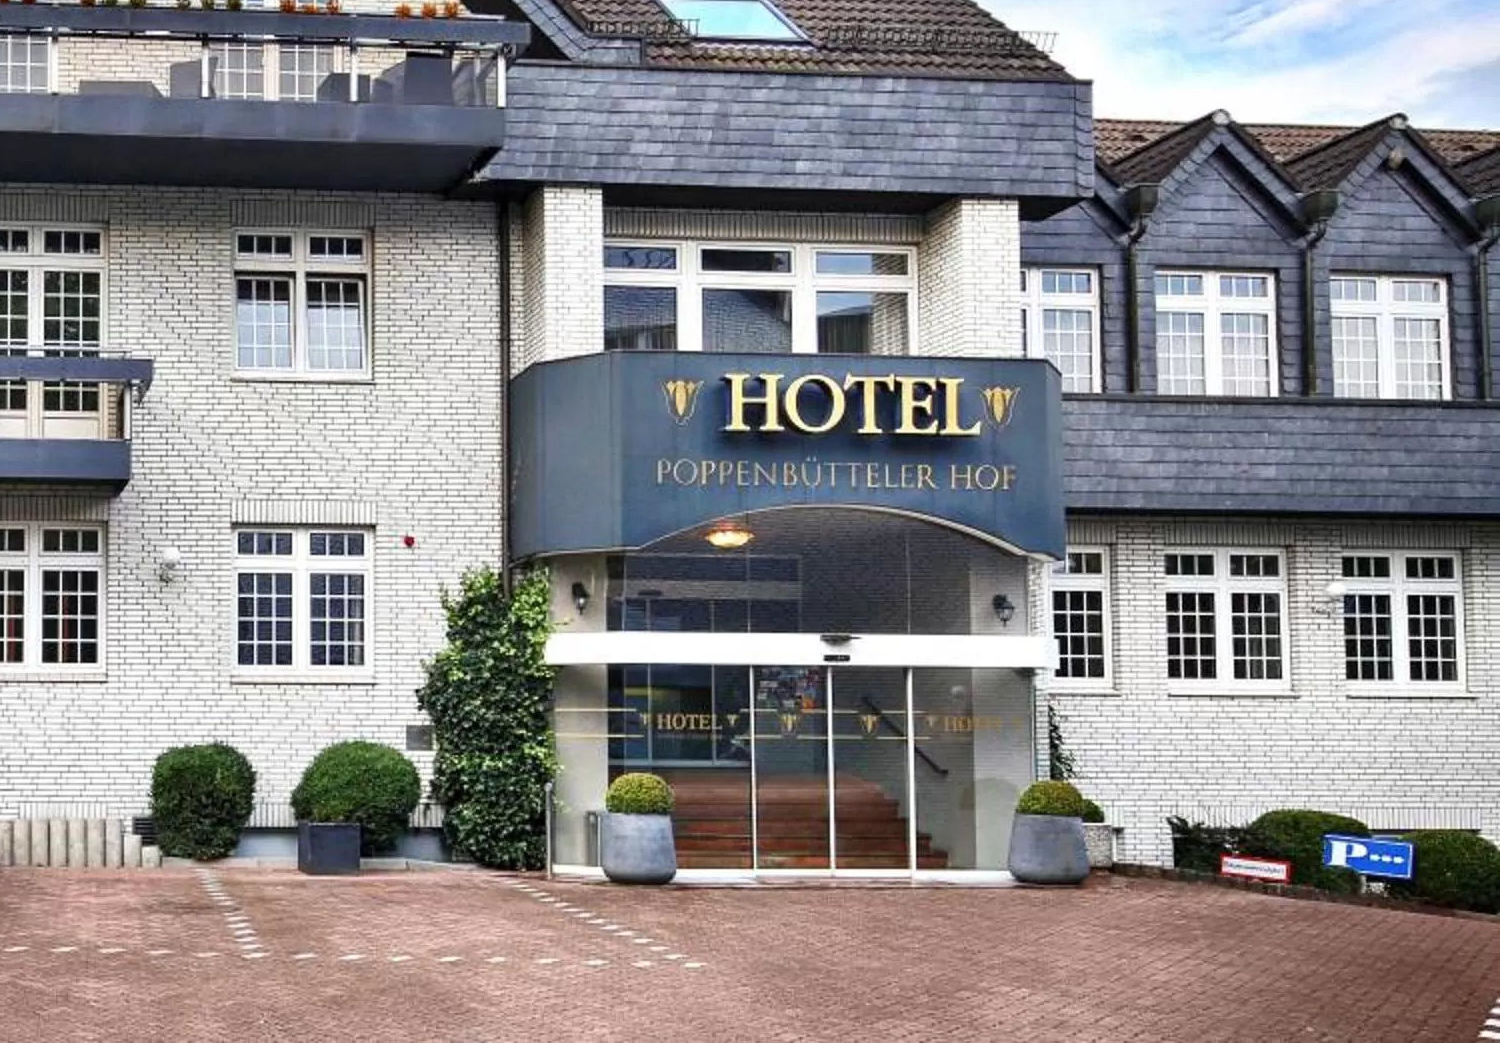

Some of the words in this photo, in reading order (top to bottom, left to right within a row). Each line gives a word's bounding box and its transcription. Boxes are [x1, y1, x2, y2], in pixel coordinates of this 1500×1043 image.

[723, 373, 982, 436] HOTEL
[656, 457, 940, 490] POPPENBÜTTELER
[949, 464, 1017, 491] HOF
[656, 713, 723, 731] HOTEL
[1326, 840, 1367, 866] P
